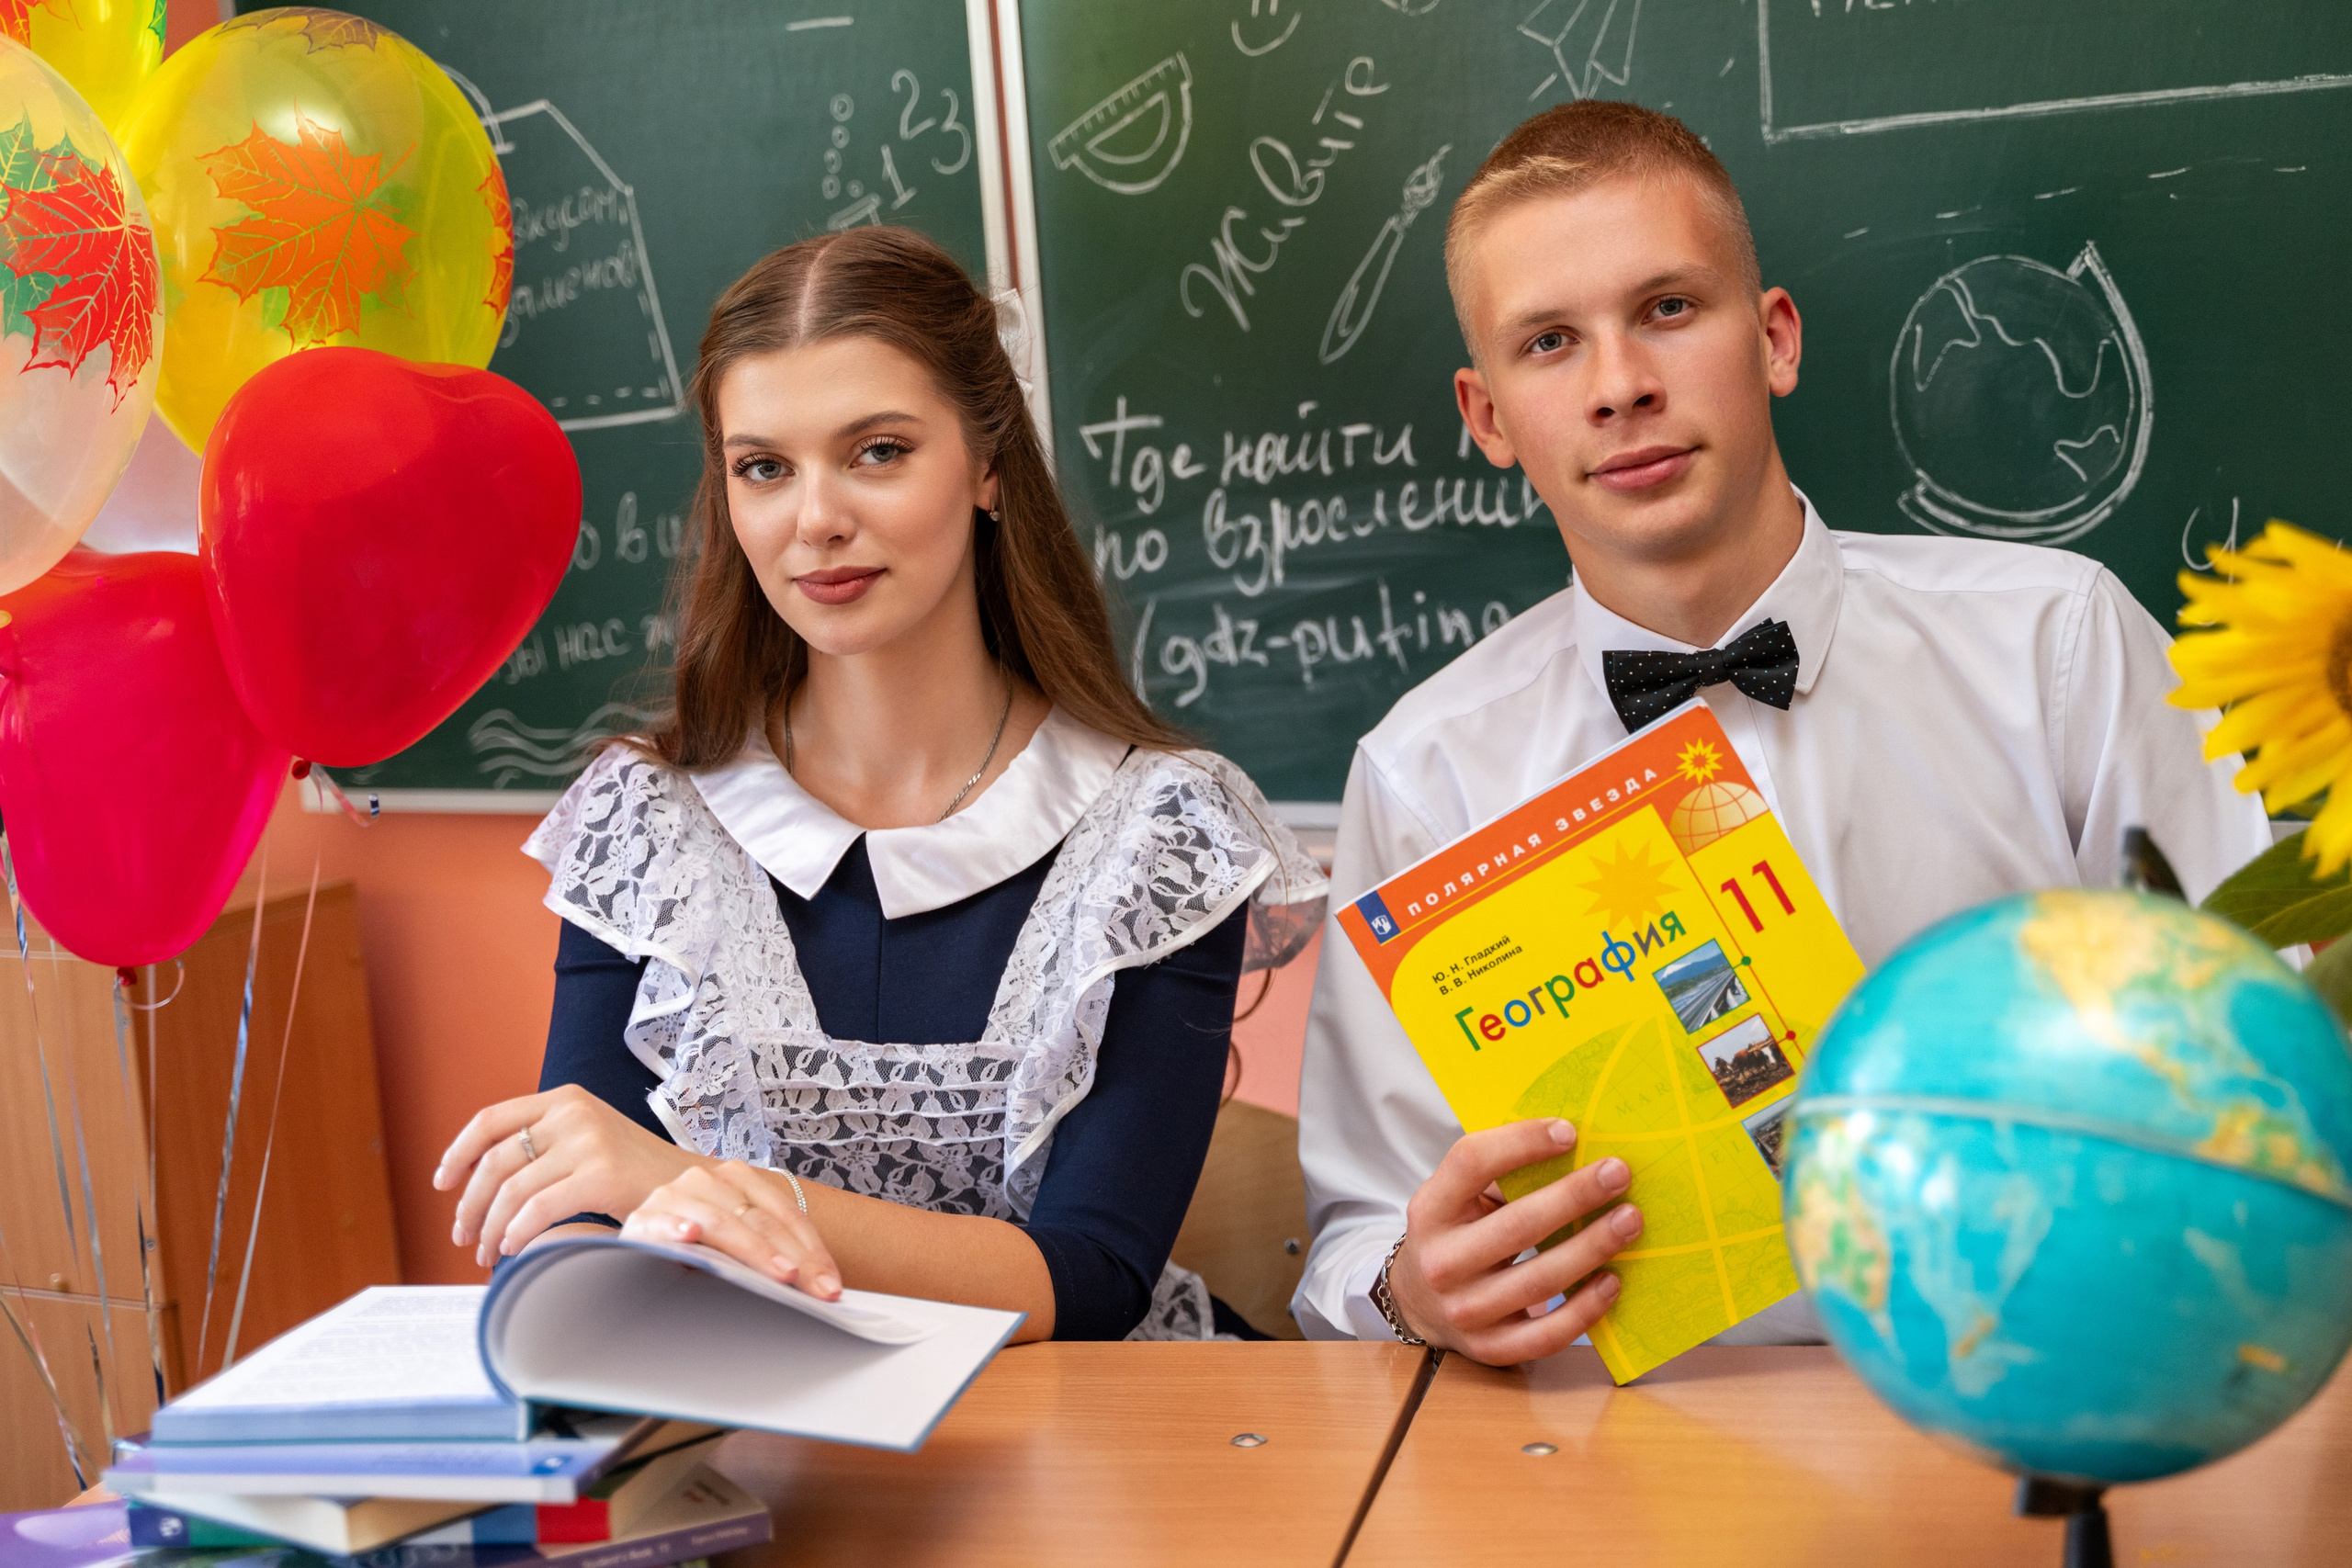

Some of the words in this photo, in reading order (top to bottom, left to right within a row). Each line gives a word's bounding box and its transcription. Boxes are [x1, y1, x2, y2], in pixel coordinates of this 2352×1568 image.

[1220, 400, 1418, 487] найти
[1407, 832, 1543, 917] ПОЛЯРНАЯ
[1555, 768, 1657, 832] ЗВЕЗДА
[1720, 860, 1796, 934] 11
[1431, 971, 1451, 985] Ю.
[1449, 963, 1464, 975] Н.
[1464, 935, 1511, 966] Гладкий
[1439, 985, 1453, 996] В.
[1453, 976, 1467, 987] В.
[1466, 945, 1523, 980] Николина
[1454, 910, 1687, 1052] География
